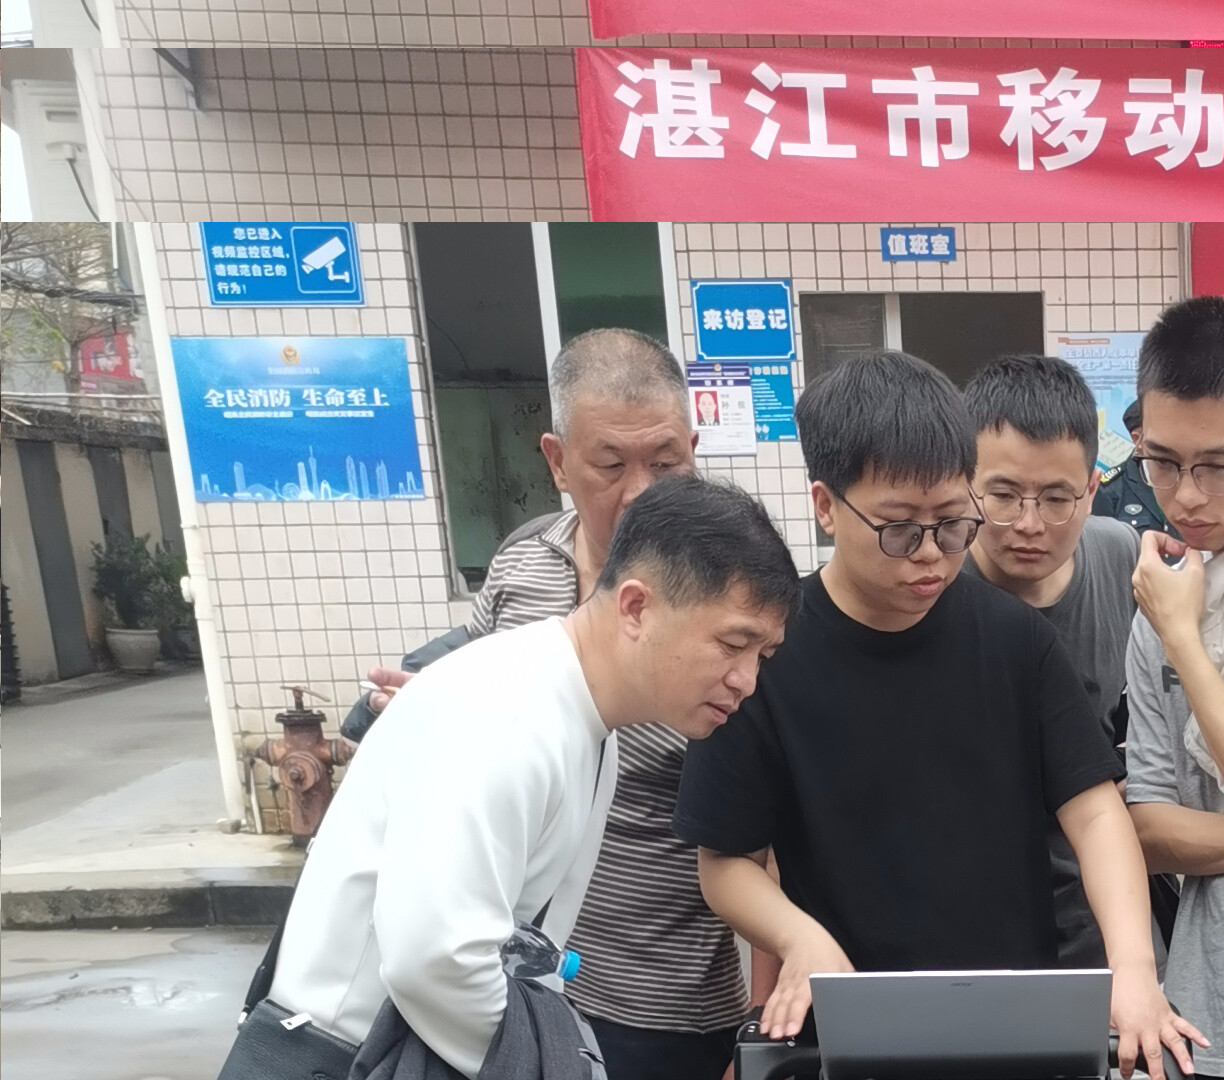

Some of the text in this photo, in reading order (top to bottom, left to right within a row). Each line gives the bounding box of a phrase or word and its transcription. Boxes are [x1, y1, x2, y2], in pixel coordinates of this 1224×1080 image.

[887, 234, 950, 256] 值班室
[703, 308, 788, 331] 来访登记
[203, 386, 390, 408] 全民消防 生命至上
